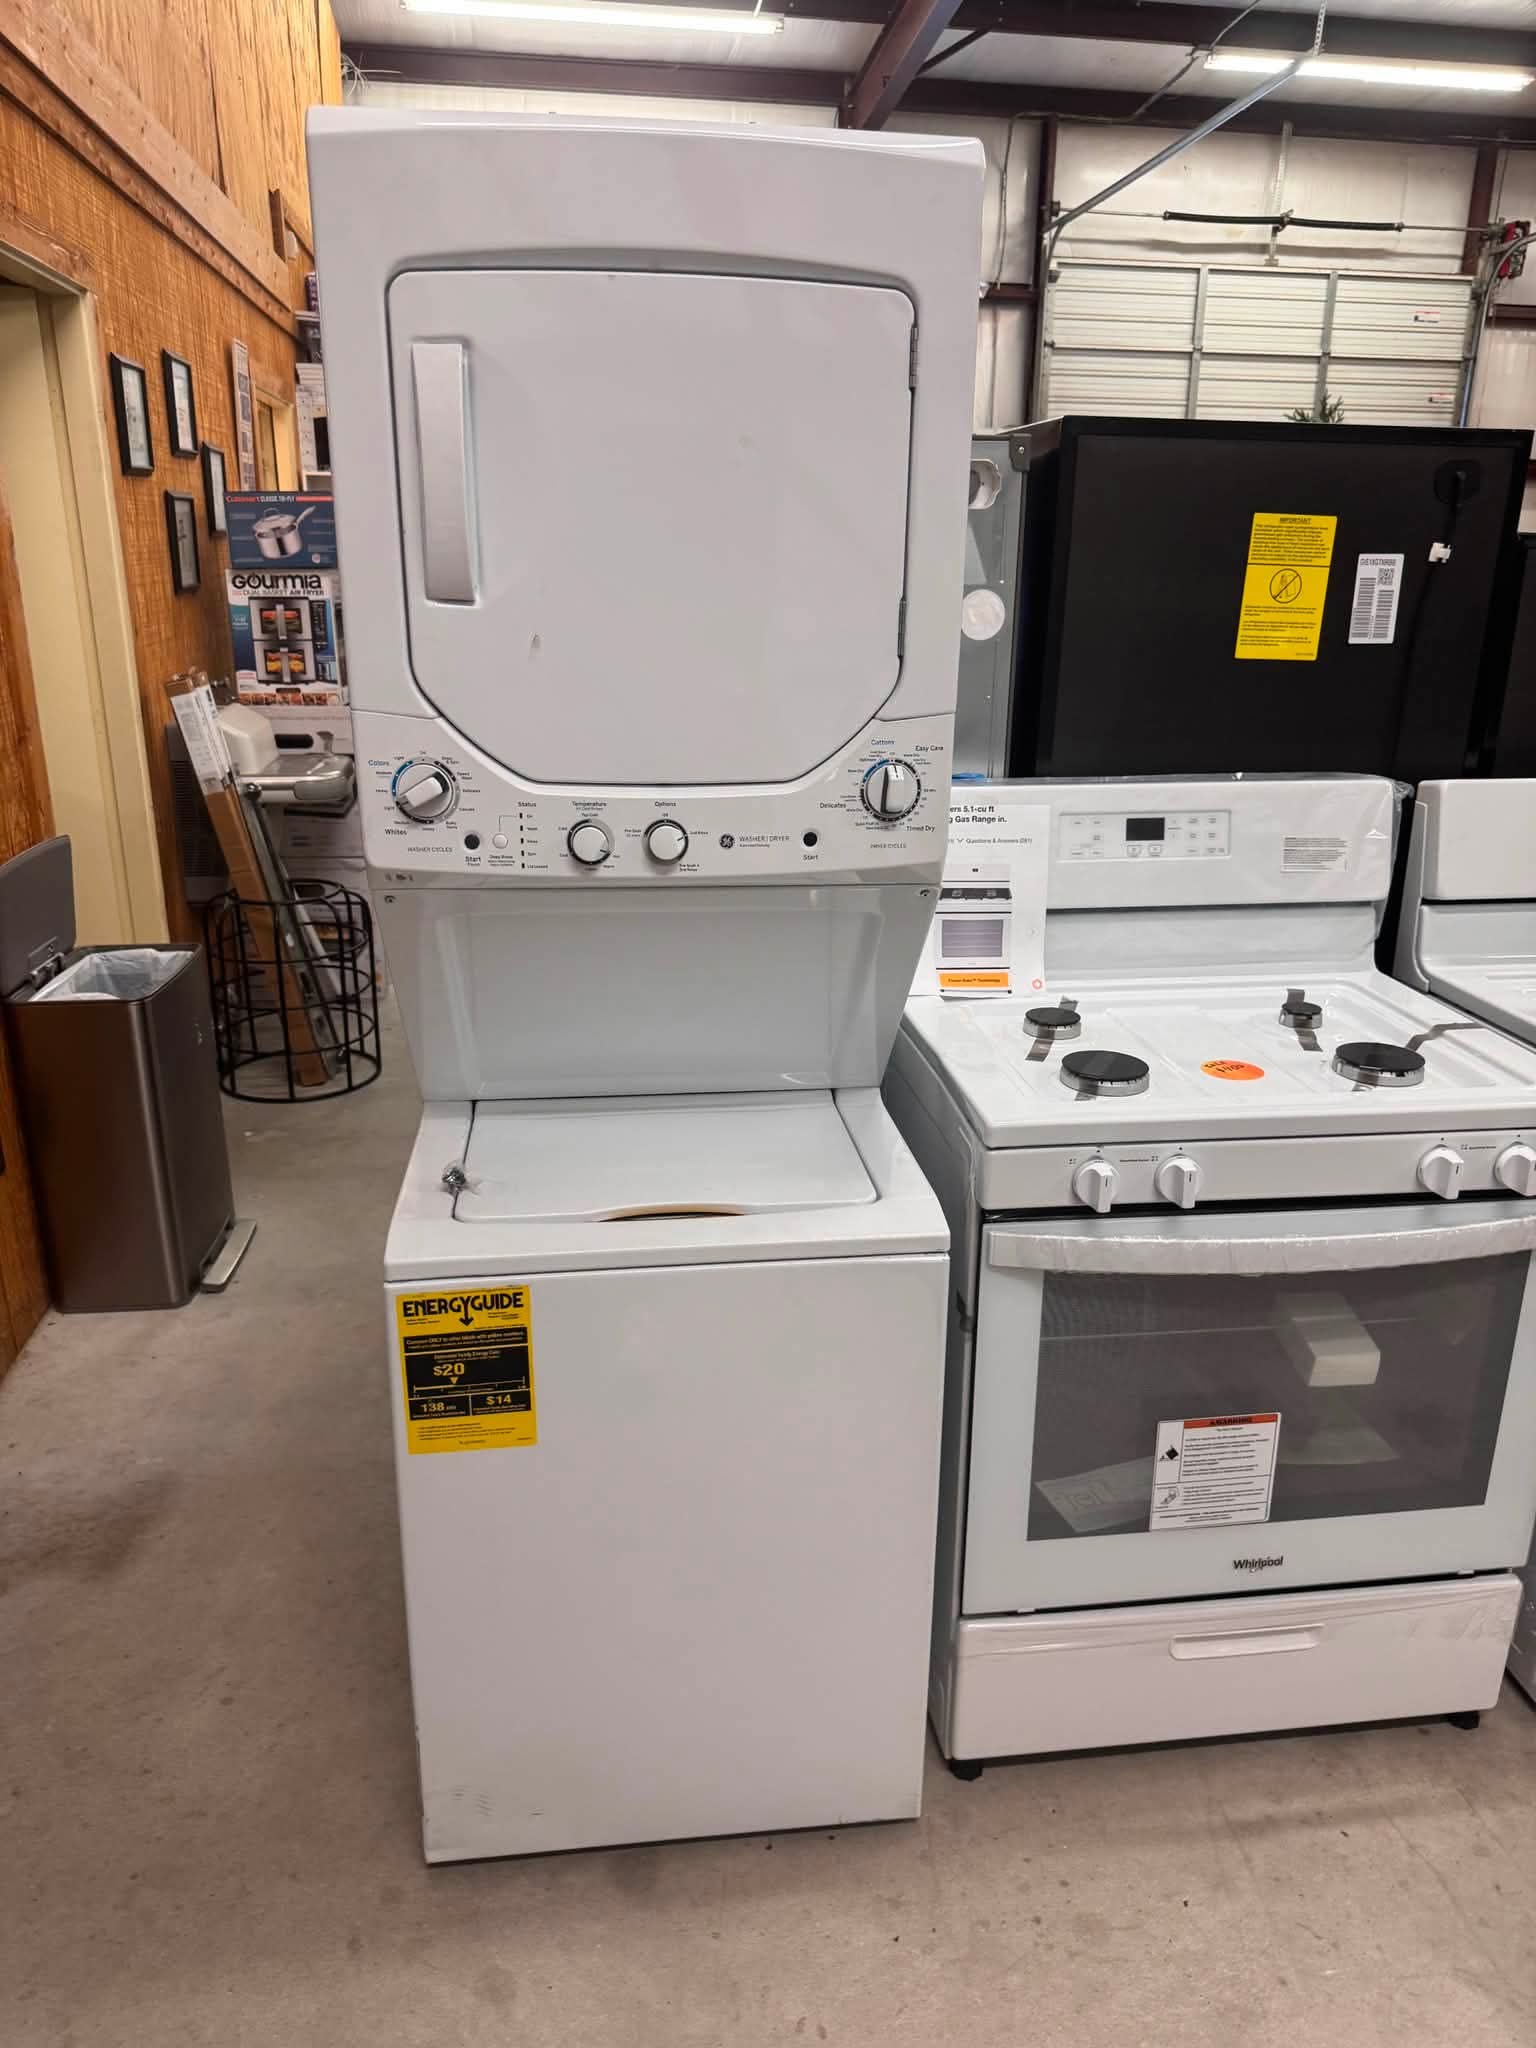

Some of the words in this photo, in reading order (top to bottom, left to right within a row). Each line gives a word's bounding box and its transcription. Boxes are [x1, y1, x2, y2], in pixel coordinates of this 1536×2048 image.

[290, 589, 302, 597] AIR
[303, 588, 325, 596] FRYER
[368, 759, 389, 768] Colors
[571, 800, 608, 809] Temperature
[654, 801, 677, 809] Options
[963, 805, 987, 813] 5.1-cu
[988, 805, 995, 813] ft
[955, 815, 970, 824] Gas
[971, 815, 996, 826] Range
[997, 814, 1008, 824] in.
[384, 828, 408, 836] Whites
[906, 825, 924, 833] Timed
[924, 825, 936, 833] Dry
[465, 855, 481, 863] Start
[402, 1292, 524, 1318] ENERGYGUIDE
[433, 1362, 465, 1377] $20
[486, 1394, 512, 1406] $14
[421, 1402, 445, 1413] 138
[1233, 1555, 1284, 1570] Whirlpool
